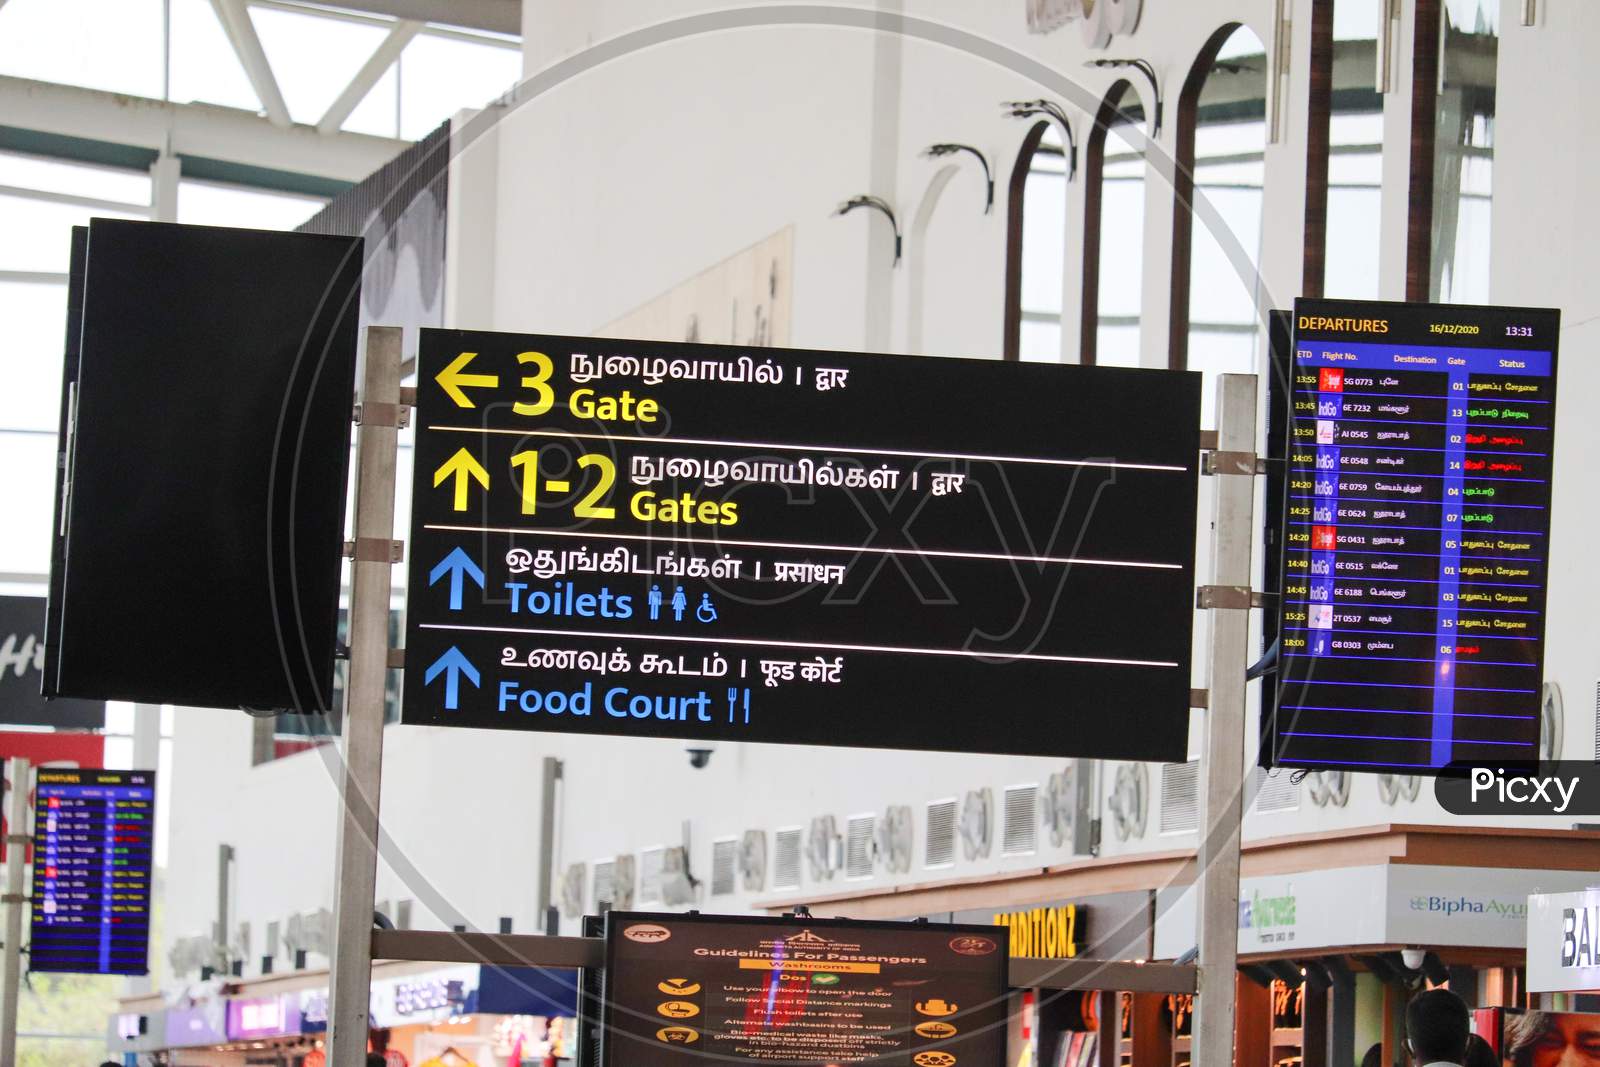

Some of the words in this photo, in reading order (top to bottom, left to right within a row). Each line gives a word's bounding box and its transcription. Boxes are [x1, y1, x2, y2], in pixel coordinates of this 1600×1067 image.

[1299, 316, 1389, 333] DEPARTURES
[1429, 323, 1480, 335] 16/12/2020
[1505, 326, 1534, 337] 13:31
[569, 353, 784, 385] நுழைவாயில்
[1296, 350, 1313, 359] ETD
[1322, 351, 1344, 361] Flight
[1344, 352, 1359, 361] No.
[1393, 354, 1438, 365] Destination
[1447, 356, 1466, 366] Gate
[1498, 359, 1526, 369] Status
[511, 350, 556, 417] 3
[815, 367, 850, 391] द्वार
[1296, 375, 1317, 384] 13:55
[1355, 378, 1373, 386] 0773
[1452, 382, 1464, 391] 01
[568, 388, 660, 423] Gate
[1295, 401, 1316, 410] 13:45
[1343, 404, 1353, 412] 6E
[1353, 404, 1372, 412] 7232
[1452, 409, 1463, 417] 13
[1293, 428, 1314, 436] 13:50
[1350, 431, 1369, 439] 0545
[1450, 435, 1462, 444] 02
[630, 455, 901, 490] நுழைவாயில்கள்
[1292, 454, 1313, 463] 14:05
[1340, 456, 1350, 464] 6E
[1350, 457, 1369, 465] 0548
[1449, 461, 1461, 470] 14
[509, 449, 617, 520] 1-2
[930, 472, 966, 496] द्वार
[1291, 480, 1312, 489] 14:20
[1349, 483, 1368, 491] 0759
[1447, 487, 1459, 496] 04
[629, 490, 738, 526] Gates
[1290, 507, 1311, 515] 14:25
[1337, 509, 1347, 517] 6E
[1347, 509, 1366, 518] 0624
[1446, 514, 1458, 522] 07
[1289, 534, 1309, 542] 14:20
[1336, 535, 1347, 543] SG
[1347, 536, 1366, 544] 0431
[1445, 540, 1457, 549] 05
[504, 546, 743, 580] ஒதுங்கிடங்கள்
[773, 561, 846, 586] प्रसाधन
[1287, 560, 1308, 568] 14:40
[1335, 562, 1345, 570] 6E
[1345, 562, 1364, 570] 0515
[1444, 566, 1455, 575] 01
[504, 581, 633, 619] Toilets
[1286, 586, 1307, 594] 14:45
[1334, 588, 1344, 596] 6E
[1344, 589, 1363, 597] 6188
[1442, 593, 1454, 601] 03
[1285, 612, 1306, 621] 15:25
[1343, 615, 1362, 623] 0537
[1442, 619, 1453, 628] 15
[1284, 639, 1305, 647] 18:00
[1343, 641, 1361, 650] 0303
[1440, 645, 1452, 654] 06
[500, 646, 632, 676] உணவுக்
[639, 651, 729, 678] கூடம்
[759, 659, 797, 688] फूड
[799, 656, 844, 684] कोर्ट
[498, 680, 593, 717] Food
[603, 686, 712, 723] Court
[693, 948, 789, 958] Guidelines
[793, 952, 824, 960] For
[826, 953, 927, 964] Passengers
[768, 962, 851, 970] Washrooms
